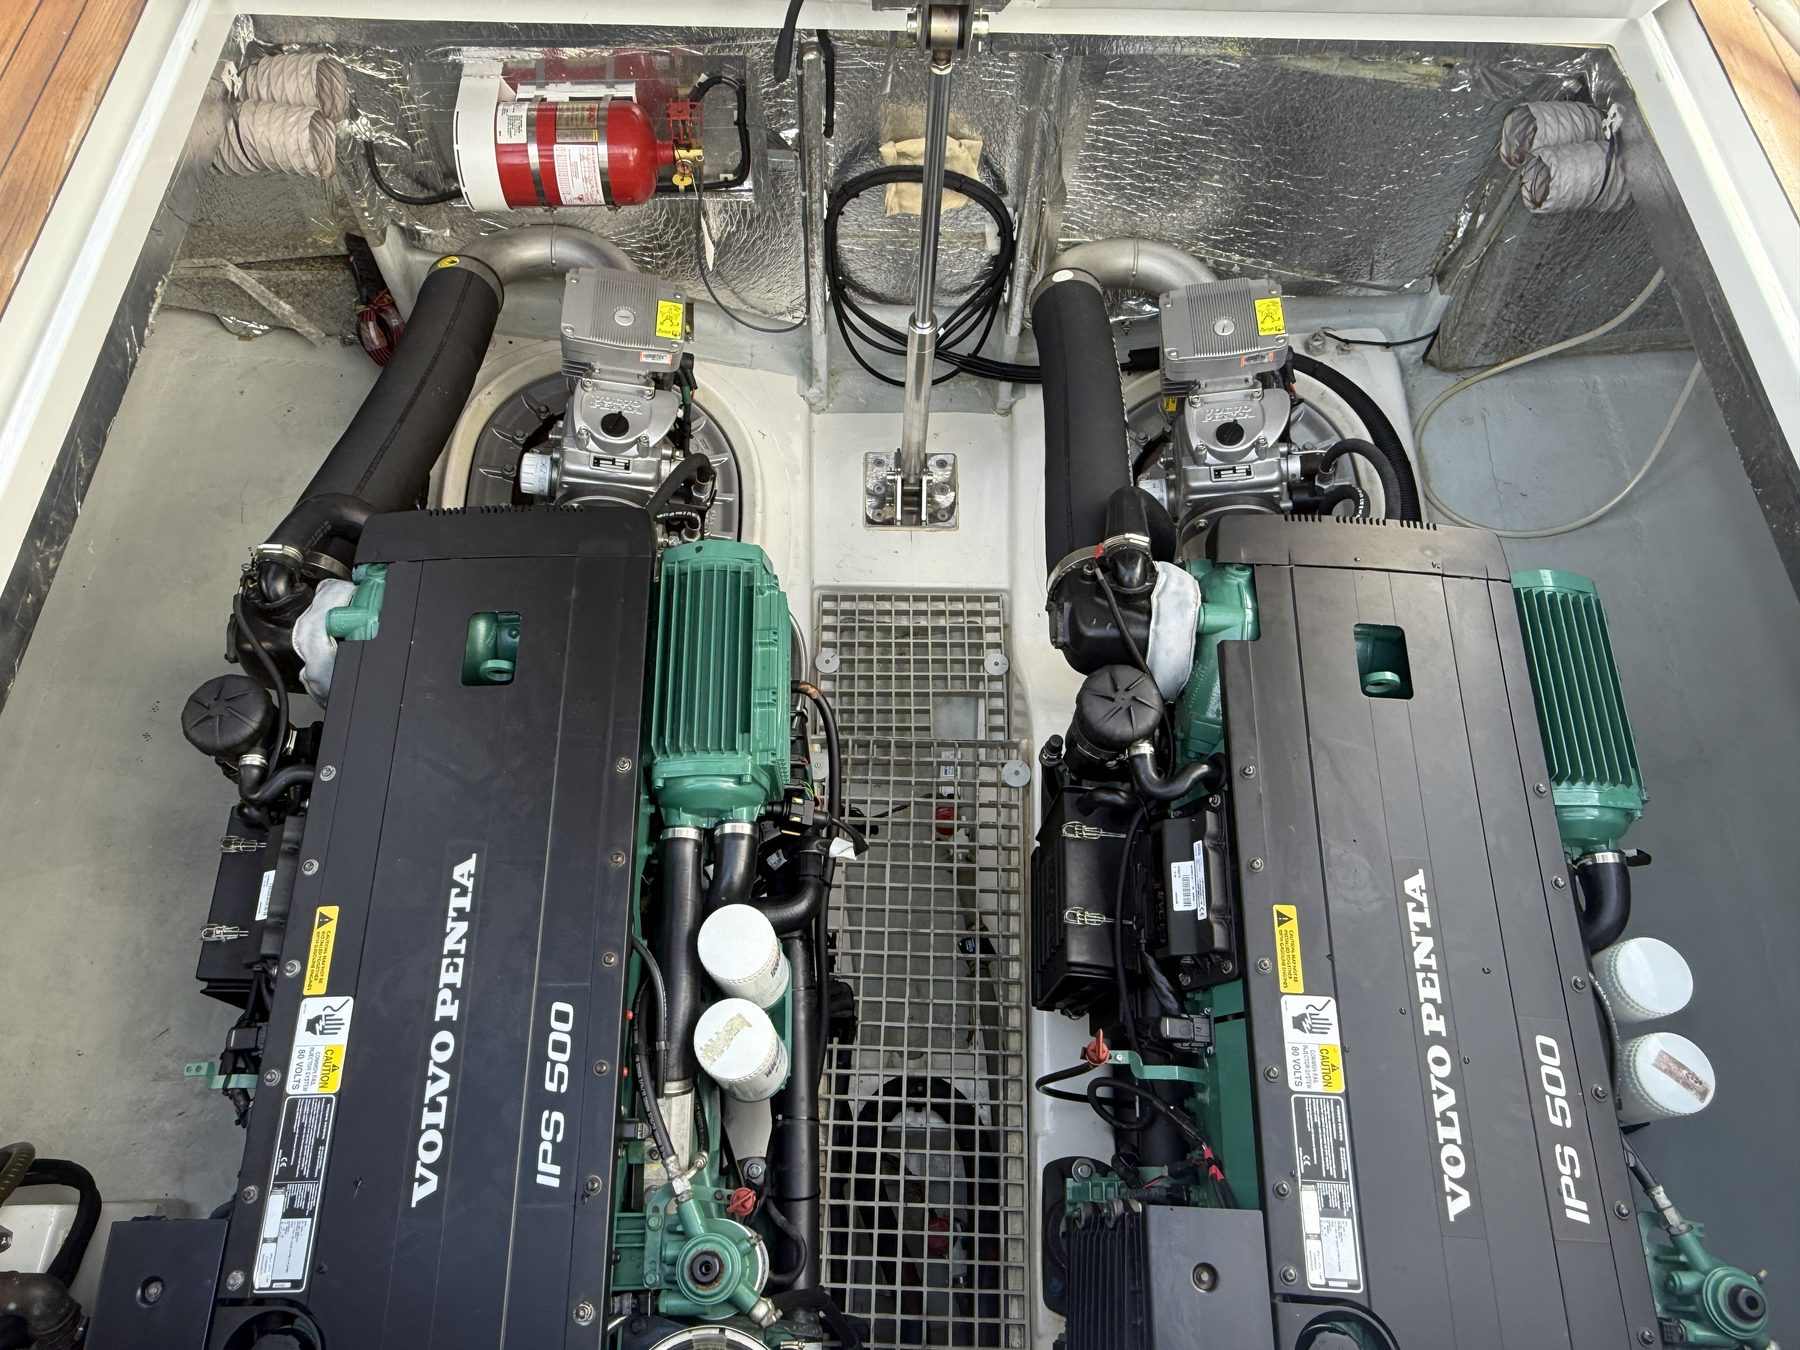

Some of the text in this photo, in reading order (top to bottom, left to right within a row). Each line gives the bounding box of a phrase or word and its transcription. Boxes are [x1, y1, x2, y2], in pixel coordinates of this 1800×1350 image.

[291, 1050, 306, 1090] 80 VOLTS
[319, 1049, 334, 1089] CAUTION
[411, 853, 477, 1208] VOLVO PENTA
[1291, 1046, 1302, 1087] 80 VOLTS
[1319, 1049, 1332, 1087] CAUTION
[1403, 868, 1471, 1222] VOLVO PENTA
[536, 1001, 574, 1188] IPS 500
[1534, 1034, 1590, 1225] IPS 500
